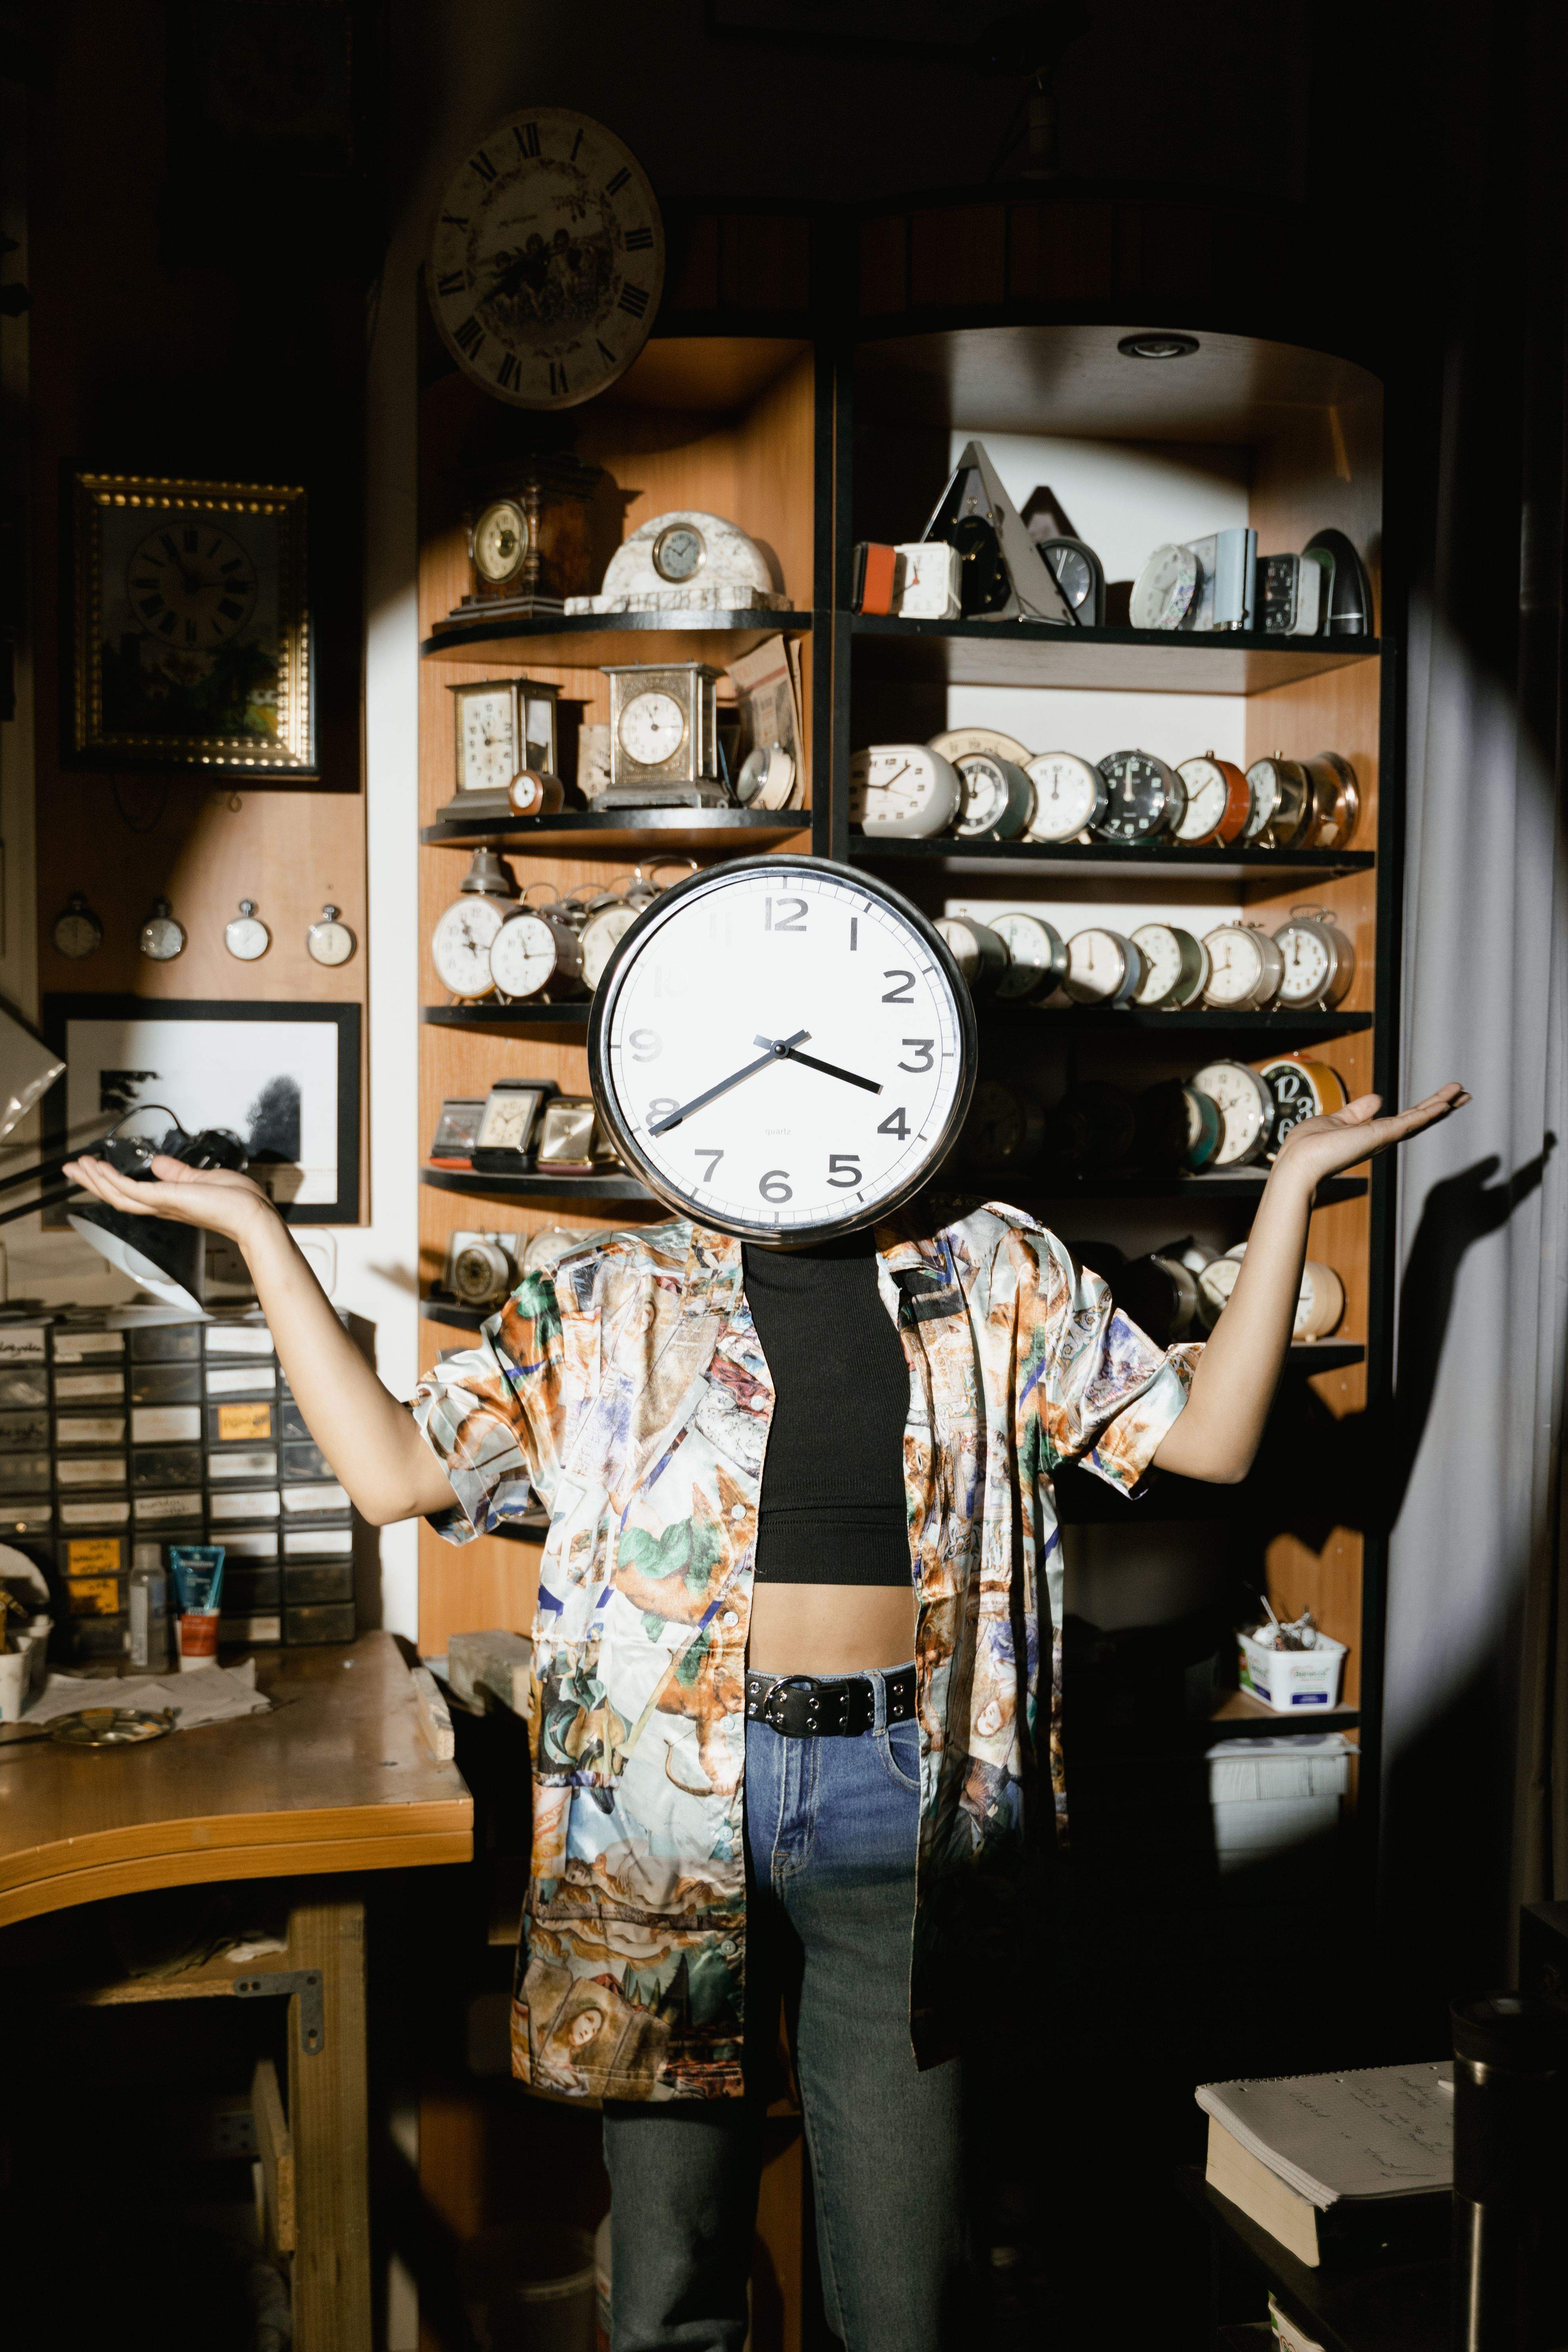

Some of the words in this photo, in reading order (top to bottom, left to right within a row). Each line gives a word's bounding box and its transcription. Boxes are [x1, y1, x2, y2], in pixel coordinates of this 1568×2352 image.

[765, 897, 809, 931] 12
[850, 917, 858, 951] 1
[882, 970, 916, 1004] 2
[629, 1028, 664, 1063] 9
[897, 1038, 934, 1073] 3
[1274, 1075, 1299, 1103] 12
[645, 1098, 683, 1131] 8
[877, 1107, 911, 1141] 4
[1296, 1097, 1313, 1122] 3
[765, 1128, 791, 1136] quartz
[694, 1149, 724, 1182] 7
[826, 1154, 863, 1188] 5
[759, 1170, 793, 1204] 6
